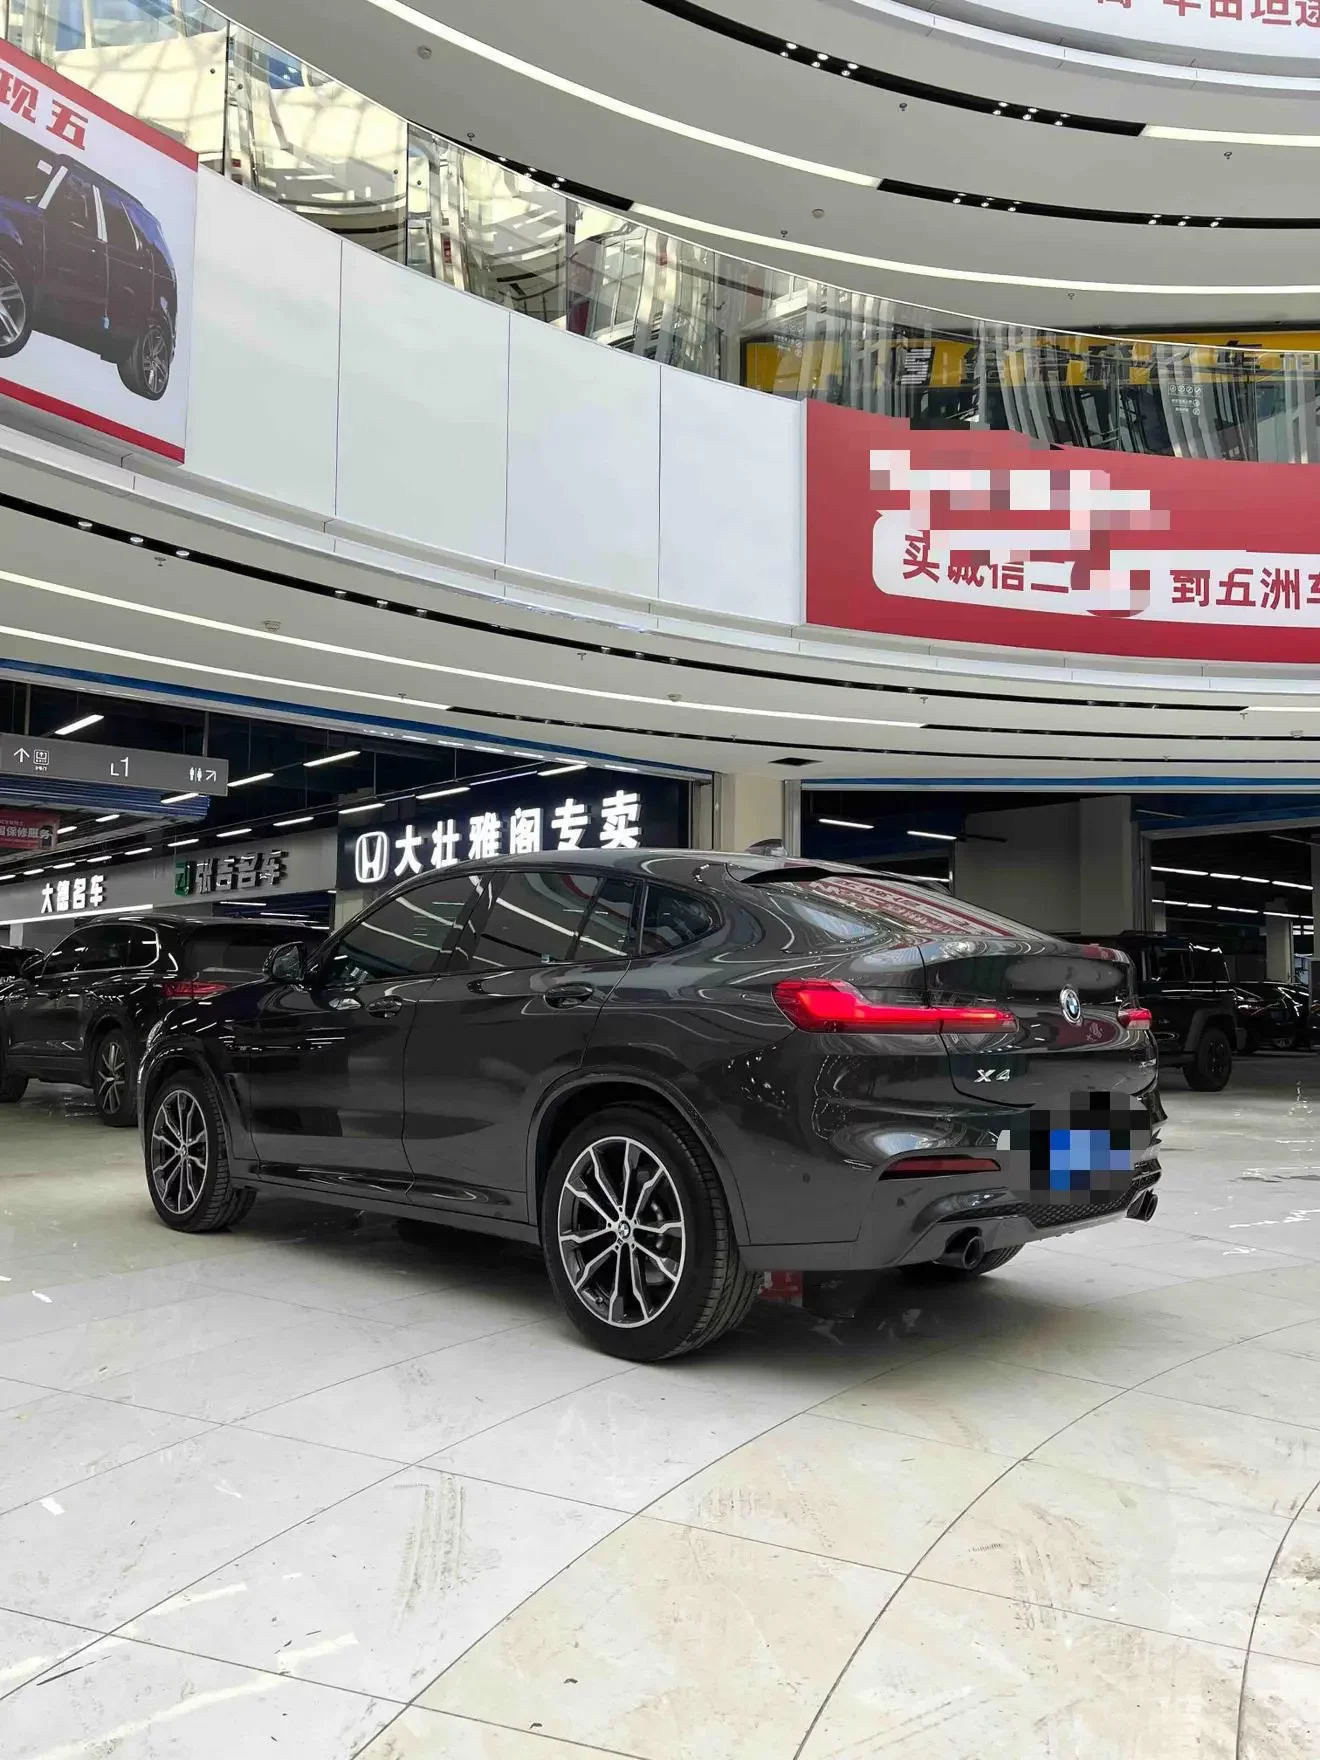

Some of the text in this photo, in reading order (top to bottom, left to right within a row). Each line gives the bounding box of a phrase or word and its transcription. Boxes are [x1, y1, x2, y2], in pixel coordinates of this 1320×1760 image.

[110, 756, 130, 777] L1
[394, 790, 641, 877] 大壮雅阁专卖
[973, 1068, 1012, 1084] X4
